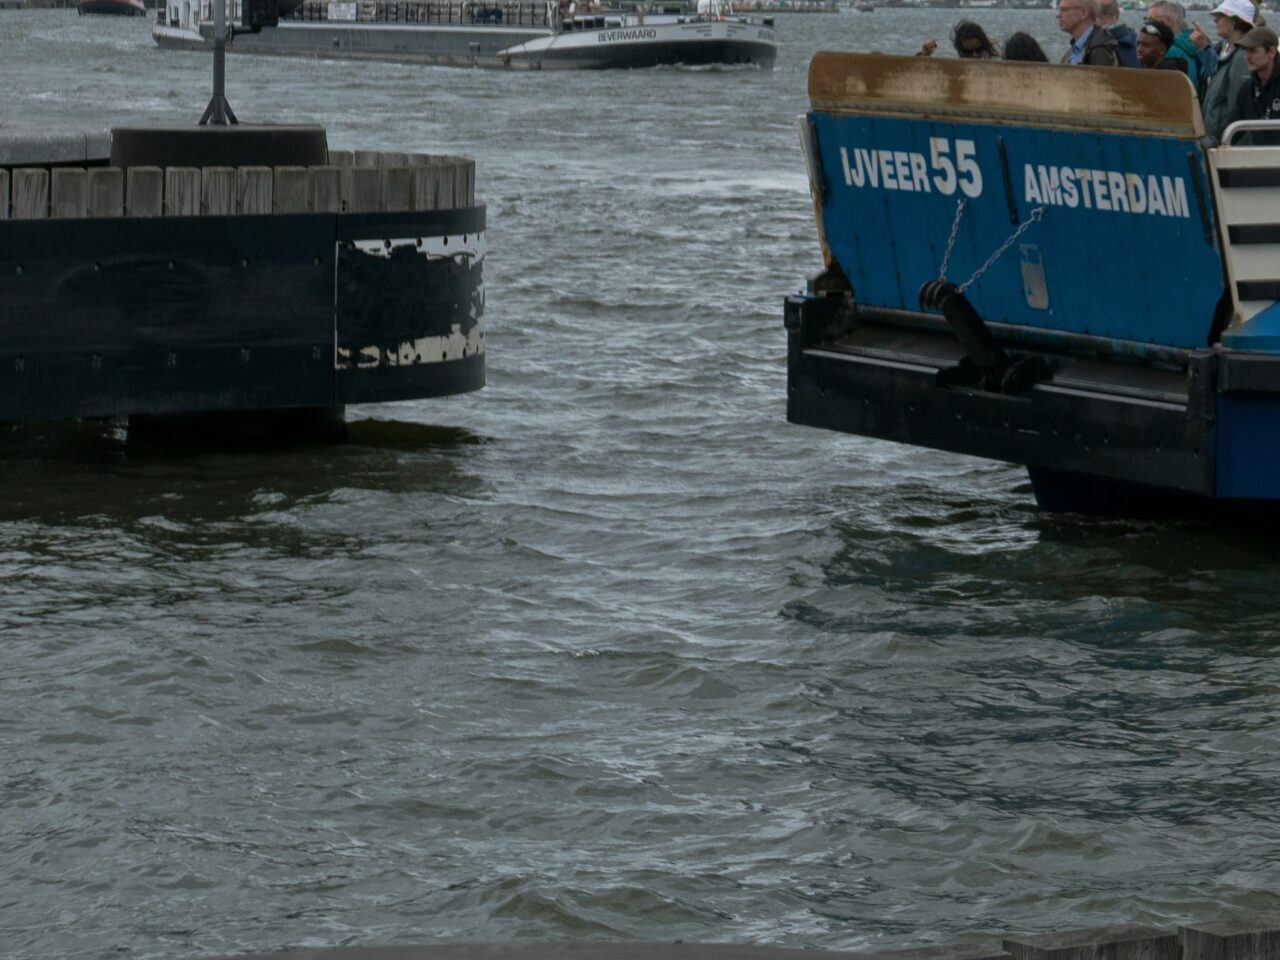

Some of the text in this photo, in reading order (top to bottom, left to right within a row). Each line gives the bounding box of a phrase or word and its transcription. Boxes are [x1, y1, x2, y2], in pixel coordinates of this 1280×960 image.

[839, 136, 984, 199] IJVEER 55
[1023, 163, 1191, 219] AMSTERDAM
